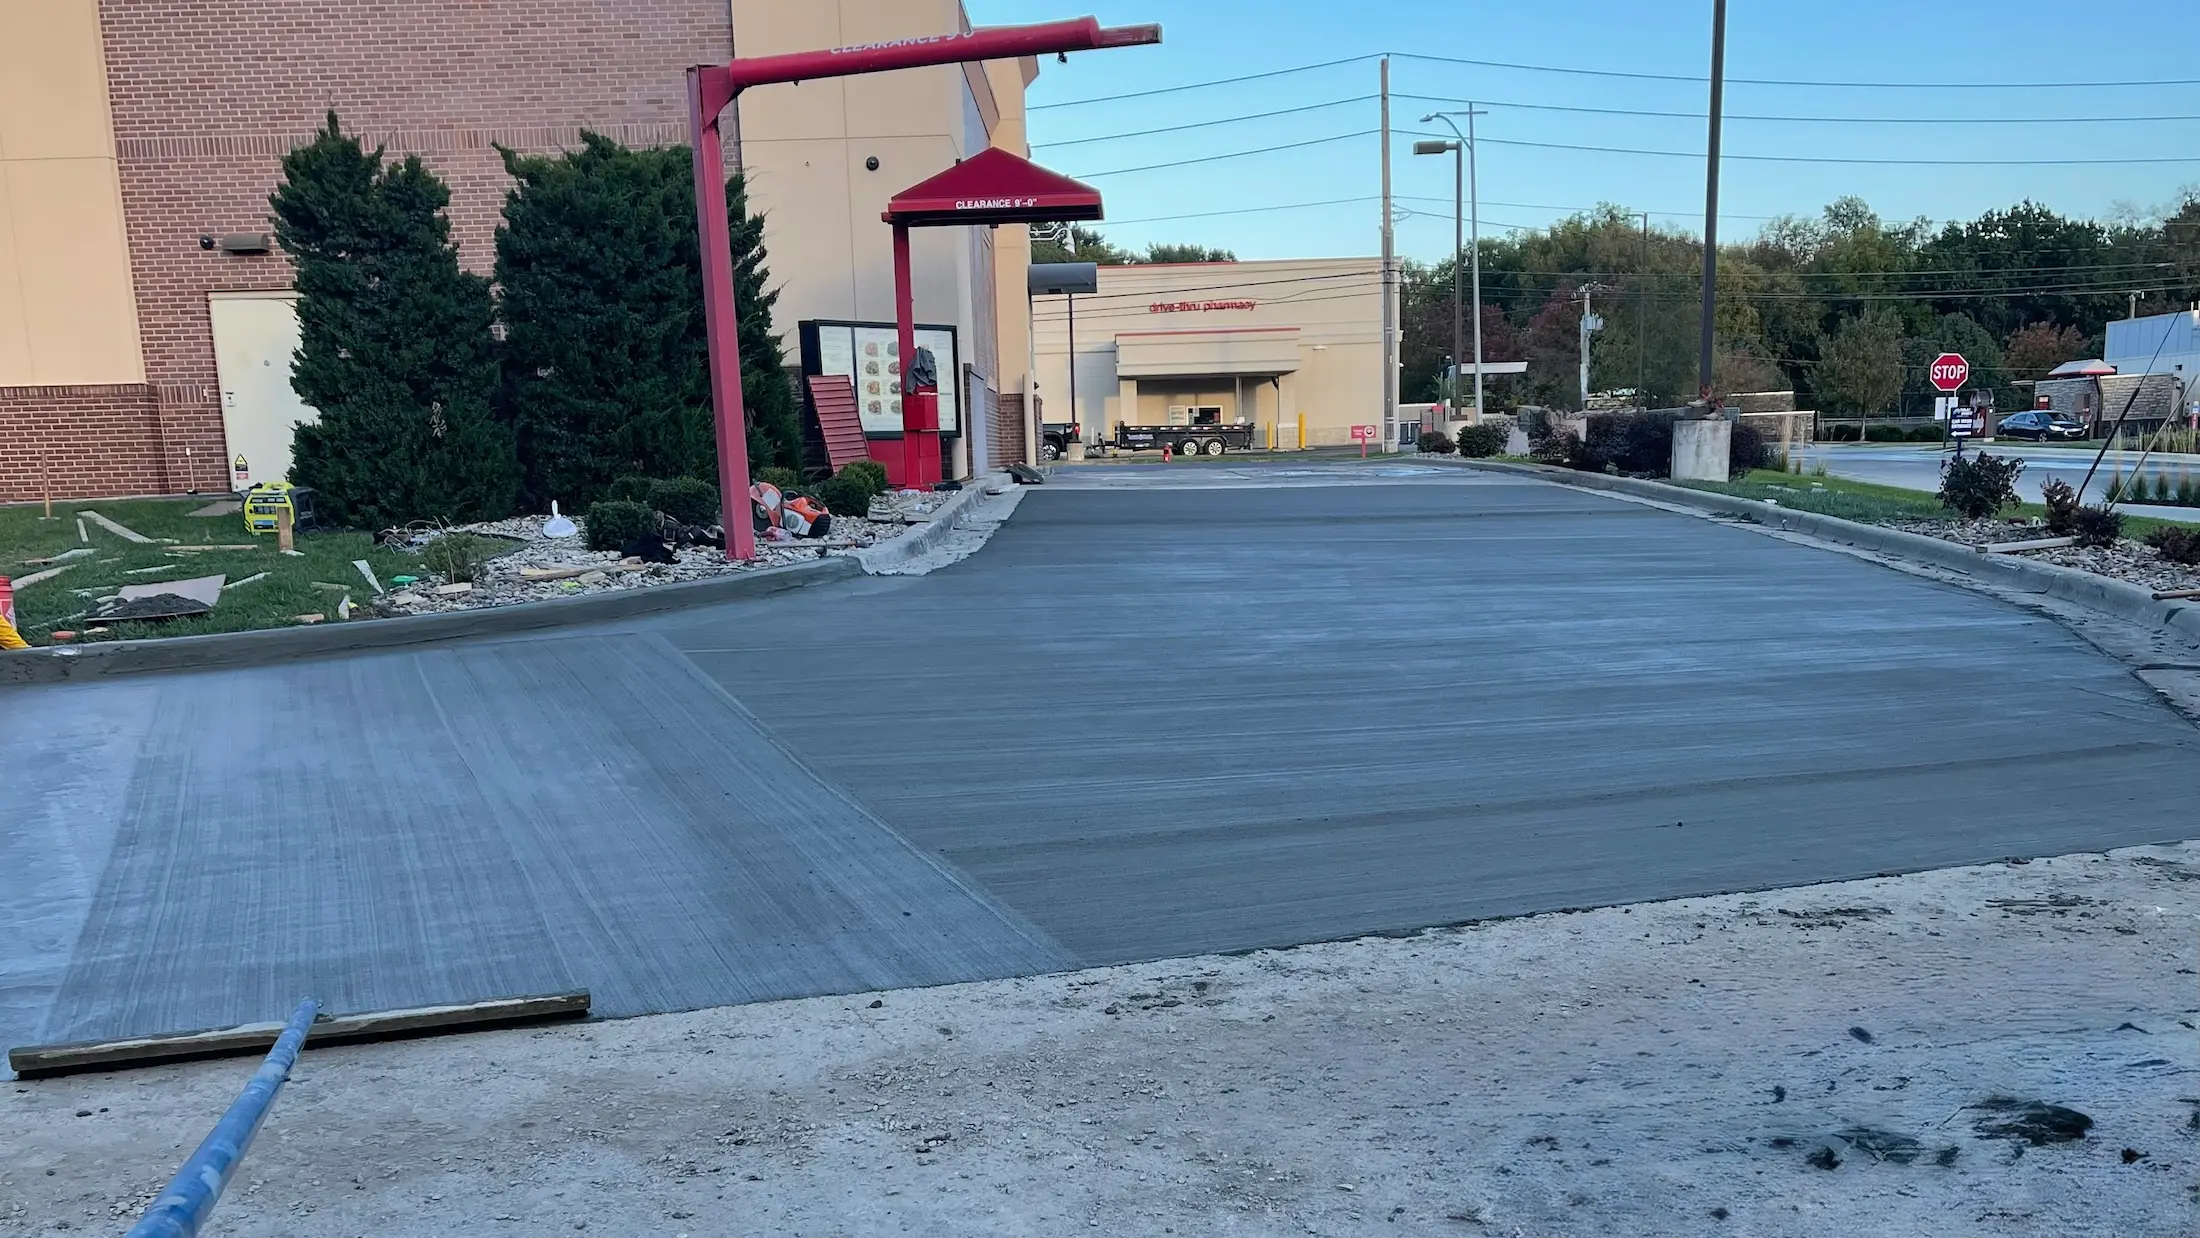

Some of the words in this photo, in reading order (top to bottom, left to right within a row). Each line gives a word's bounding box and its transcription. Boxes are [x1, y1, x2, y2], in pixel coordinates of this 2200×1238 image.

[955, 199, 1011, 210] CLEARANCE
[1149, 301, 1200, 313] drive-thru
[1203, 300, 1257, 313] pharmacy
[1933, 365, 1966, 380] STOP
